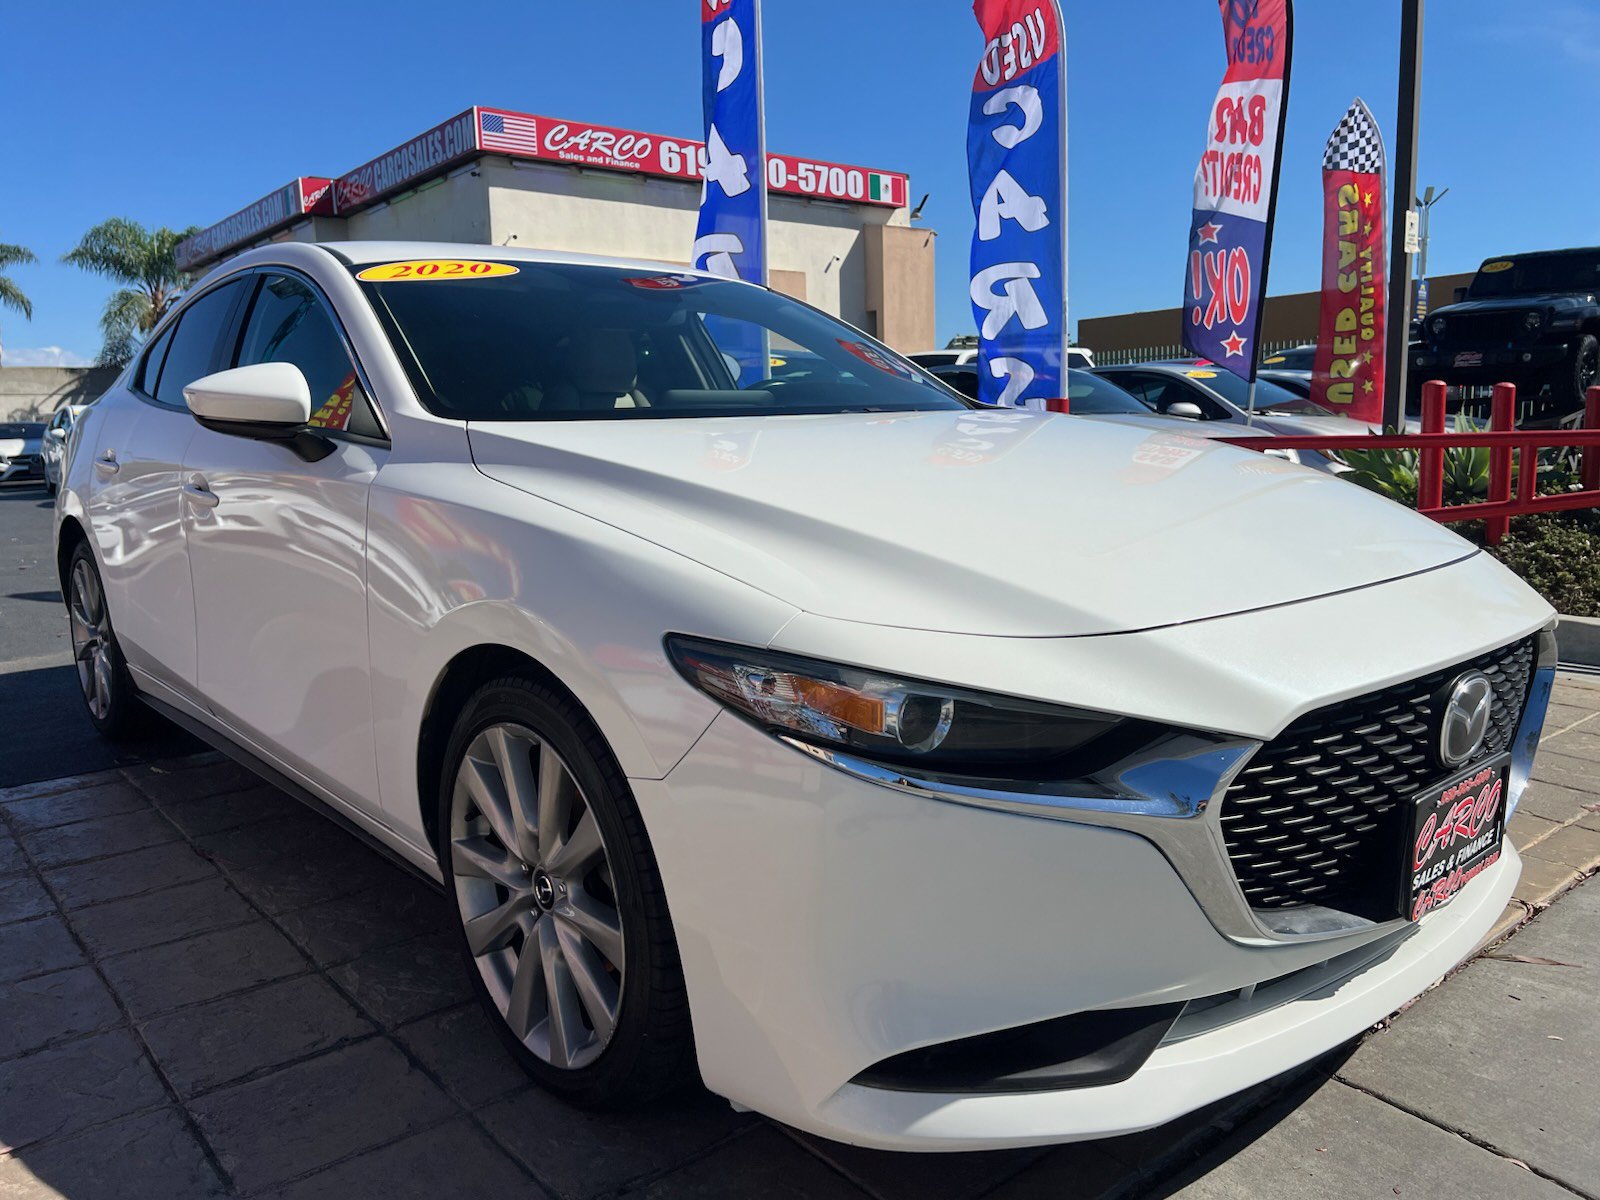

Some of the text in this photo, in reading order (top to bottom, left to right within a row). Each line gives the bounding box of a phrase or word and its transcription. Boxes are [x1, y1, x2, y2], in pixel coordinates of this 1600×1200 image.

[373, 113, 475, 193] CARCOSALES.COM
[543, 124, 652, 161] CARCO
[558, 150, 641, 169] Sales and Finance
[211, 192, 284, 251] CARCOSALES.COM
[389, 262, 492, 279] 2020
[1413, 777, 1502, 871] CARCO
[1412, 829, 1494, 890] SALES & FINANCE
